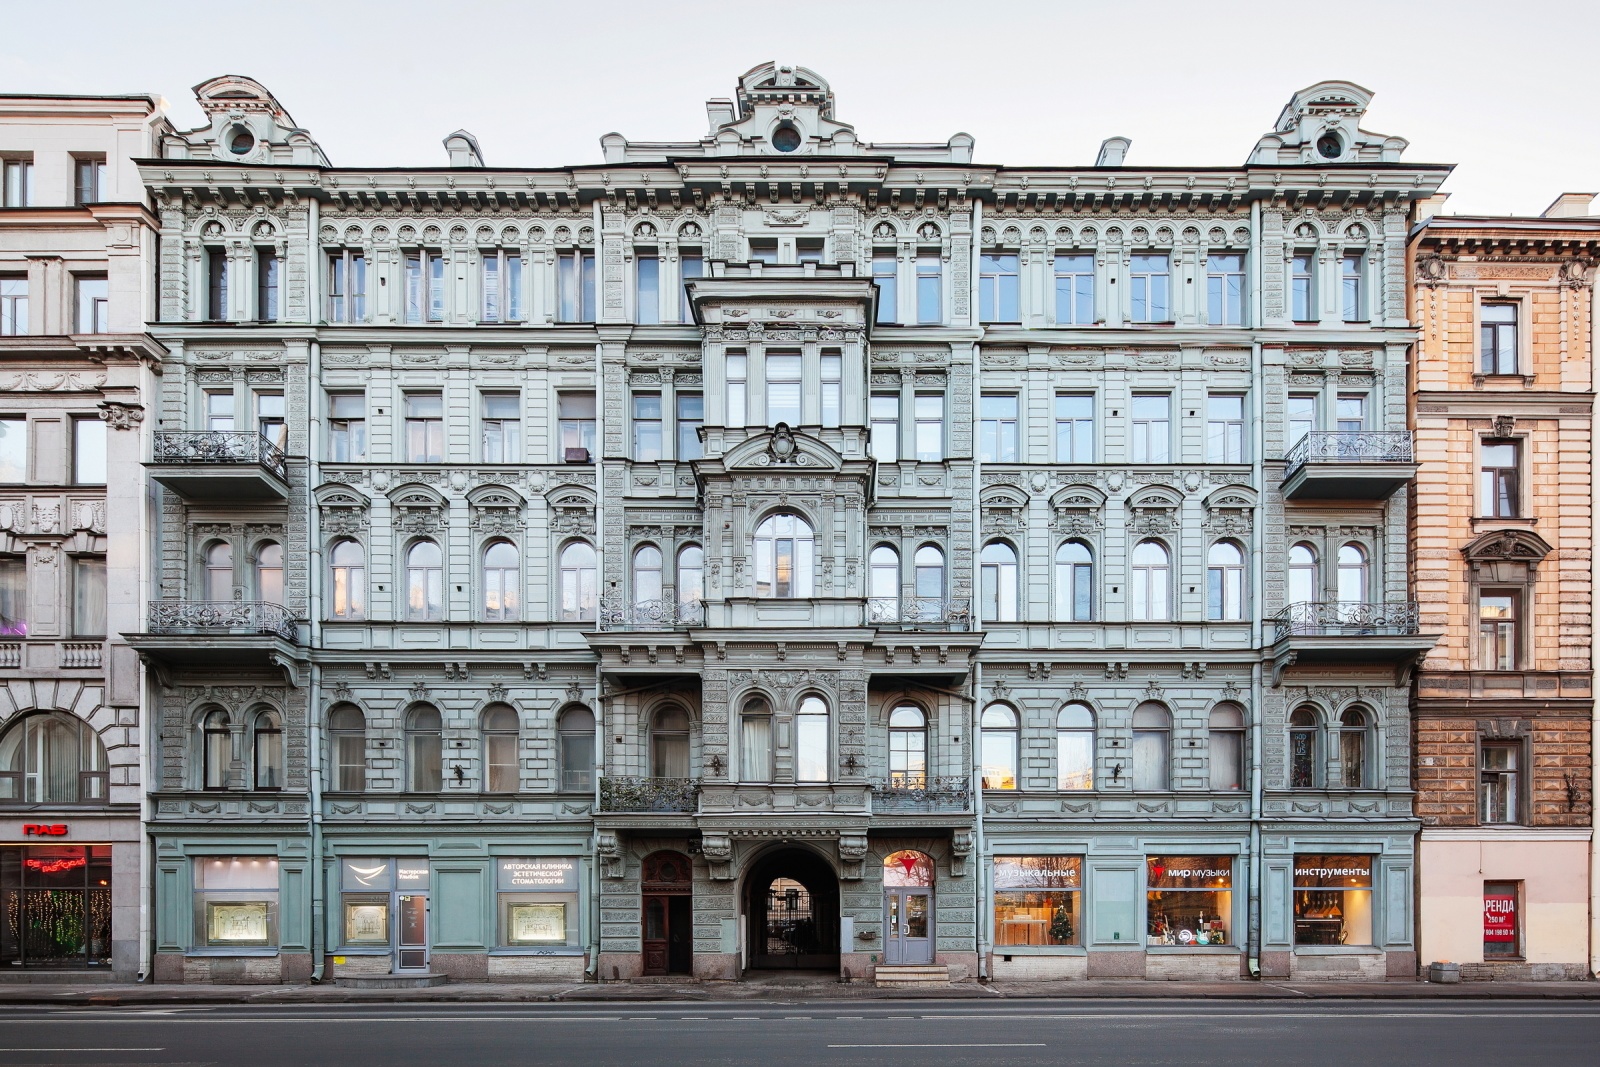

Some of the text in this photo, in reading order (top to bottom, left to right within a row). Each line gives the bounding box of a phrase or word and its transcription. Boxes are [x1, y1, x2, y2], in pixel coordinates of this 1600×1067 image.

[23, 824, 67, 836] ПАБ
[999, 869, 1076, 879] музыкальные
[1168, 869, 1230, 878] мир музыки
[1295, 868, 1370, 878] инструменты
